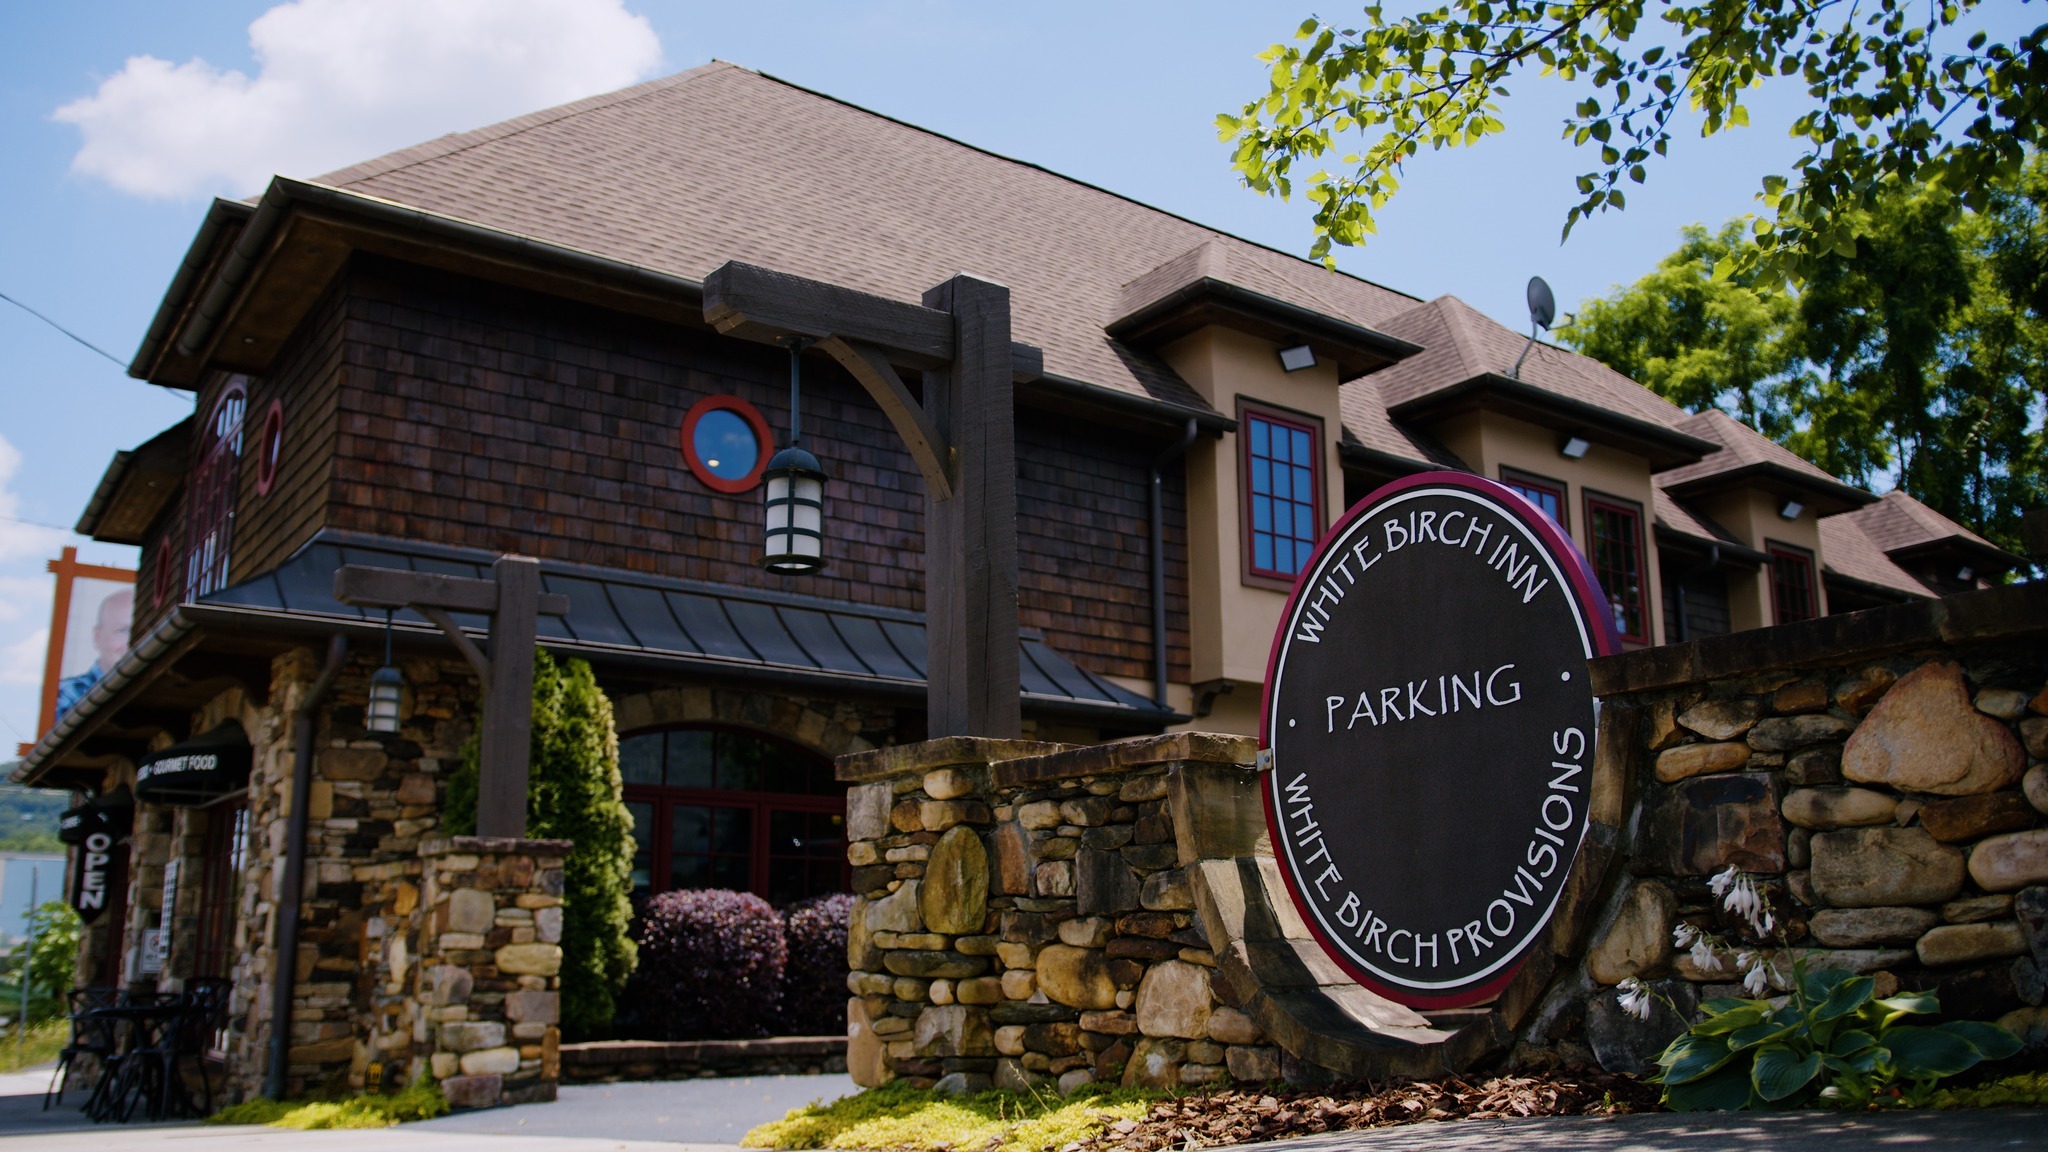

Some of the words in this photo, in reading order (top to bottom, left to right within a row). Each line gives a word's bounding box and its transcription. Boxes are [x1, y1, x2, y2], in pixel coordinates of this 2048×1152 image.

[1296, 535, 1382, 643] WHITE
[1383, 510, 1494, 555] BIRCH
[1487, 534, 1549, 604] INN
[1326, 663, 1521, 733] PARKING
[153, 756, 188, 775] GOURMET
[188, 754, 218, 771] FOOD
[79, 832, 111, 910] OPEN
[1284, 772, 1343, 902] WHITE
[1335, 890, 1438, 968] BIRCH
[1446, 727, 1586, 965] PROVISIONS
